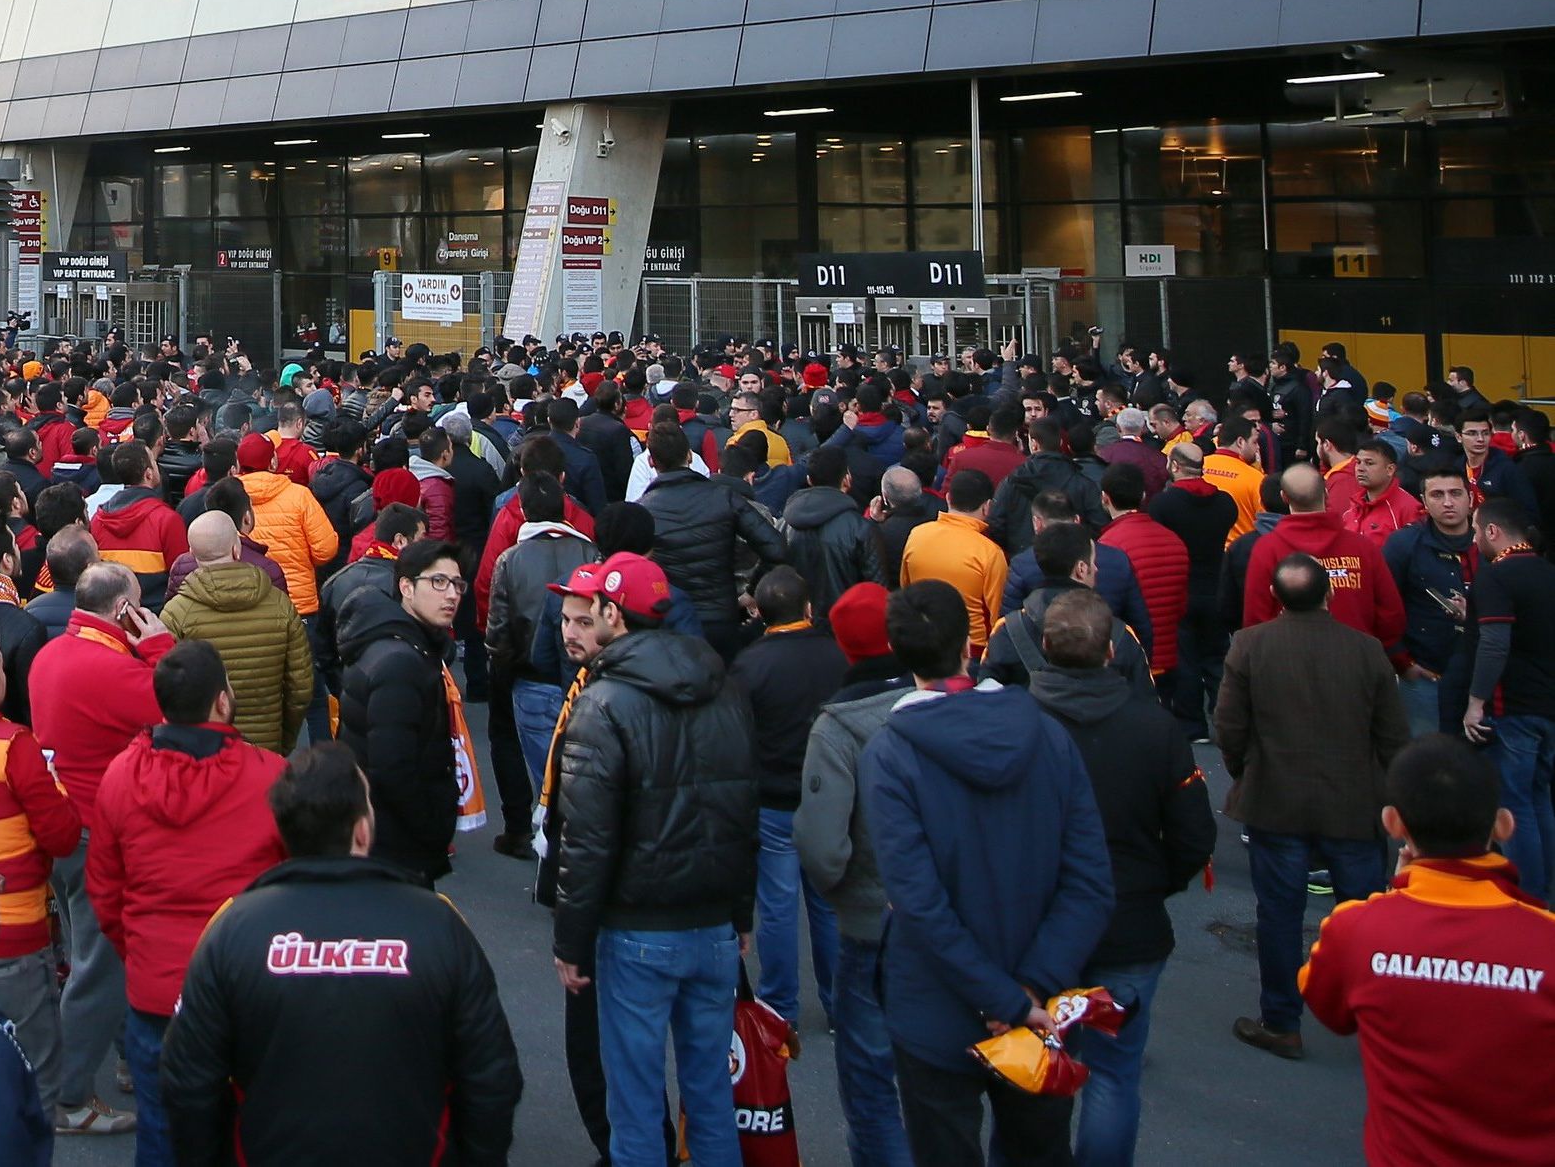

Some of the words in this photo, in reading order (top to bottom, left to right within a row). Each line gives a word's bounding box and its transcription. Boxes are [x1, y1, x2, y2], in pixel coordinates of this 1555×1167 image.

[569, 205, 590, 216] Doğu
[592, 206, 607, 215] D11
[448, 232, 479, 243] Danışma
[563, 235, 583, 246] Doğu
[584, 236, 597, 245] VIP
[597, 236, 603, 245] 2
[220, 253, 225, 265] 2
[227, 250, 237, 258] VIP
[238, 248, 254, 258] DOĞU
[383, 252, 391, 265] 9
[470, 248, 489, 259] Girişi
[646, 246, 658, 259] ĞU
[660, 246, 685, 262] GİRİŞİ
[1139, 253, 1161, 263] HDI
[59, 257, 69, 266] VIP
[70, 255, 88, 266] DOĞU
[89, 255, 109, 268] GİRİŞİ
[650, 263, 681, 271] ENTRANCE
[1338, 254, 1365, 273] 11
[53, 269, 64, 278] VIP
[64, 269, 81, 278] EAST
[81, 269, 116, 279] ENTRANCE
[816, 265, 845, 286] D11
[929, 262, 963, 285] D11
[1509, 274, 1524, 283] 111
[1529, 274, 1544, 284] 112
[417, 278, 447, 290] YARDIM
[866, 285, 895, 295] 111-112-113
[414, 293, 450, 305] NOKTASI
[1380, 316, 1391, 326] 11
[1328, 572, 1361, 589] NDISI
[268, 932, 411, 976] ÜLKER
[1371, 952, 1544, 993] GALATASARAY
[734, 1107, 784, 1131] ORE
